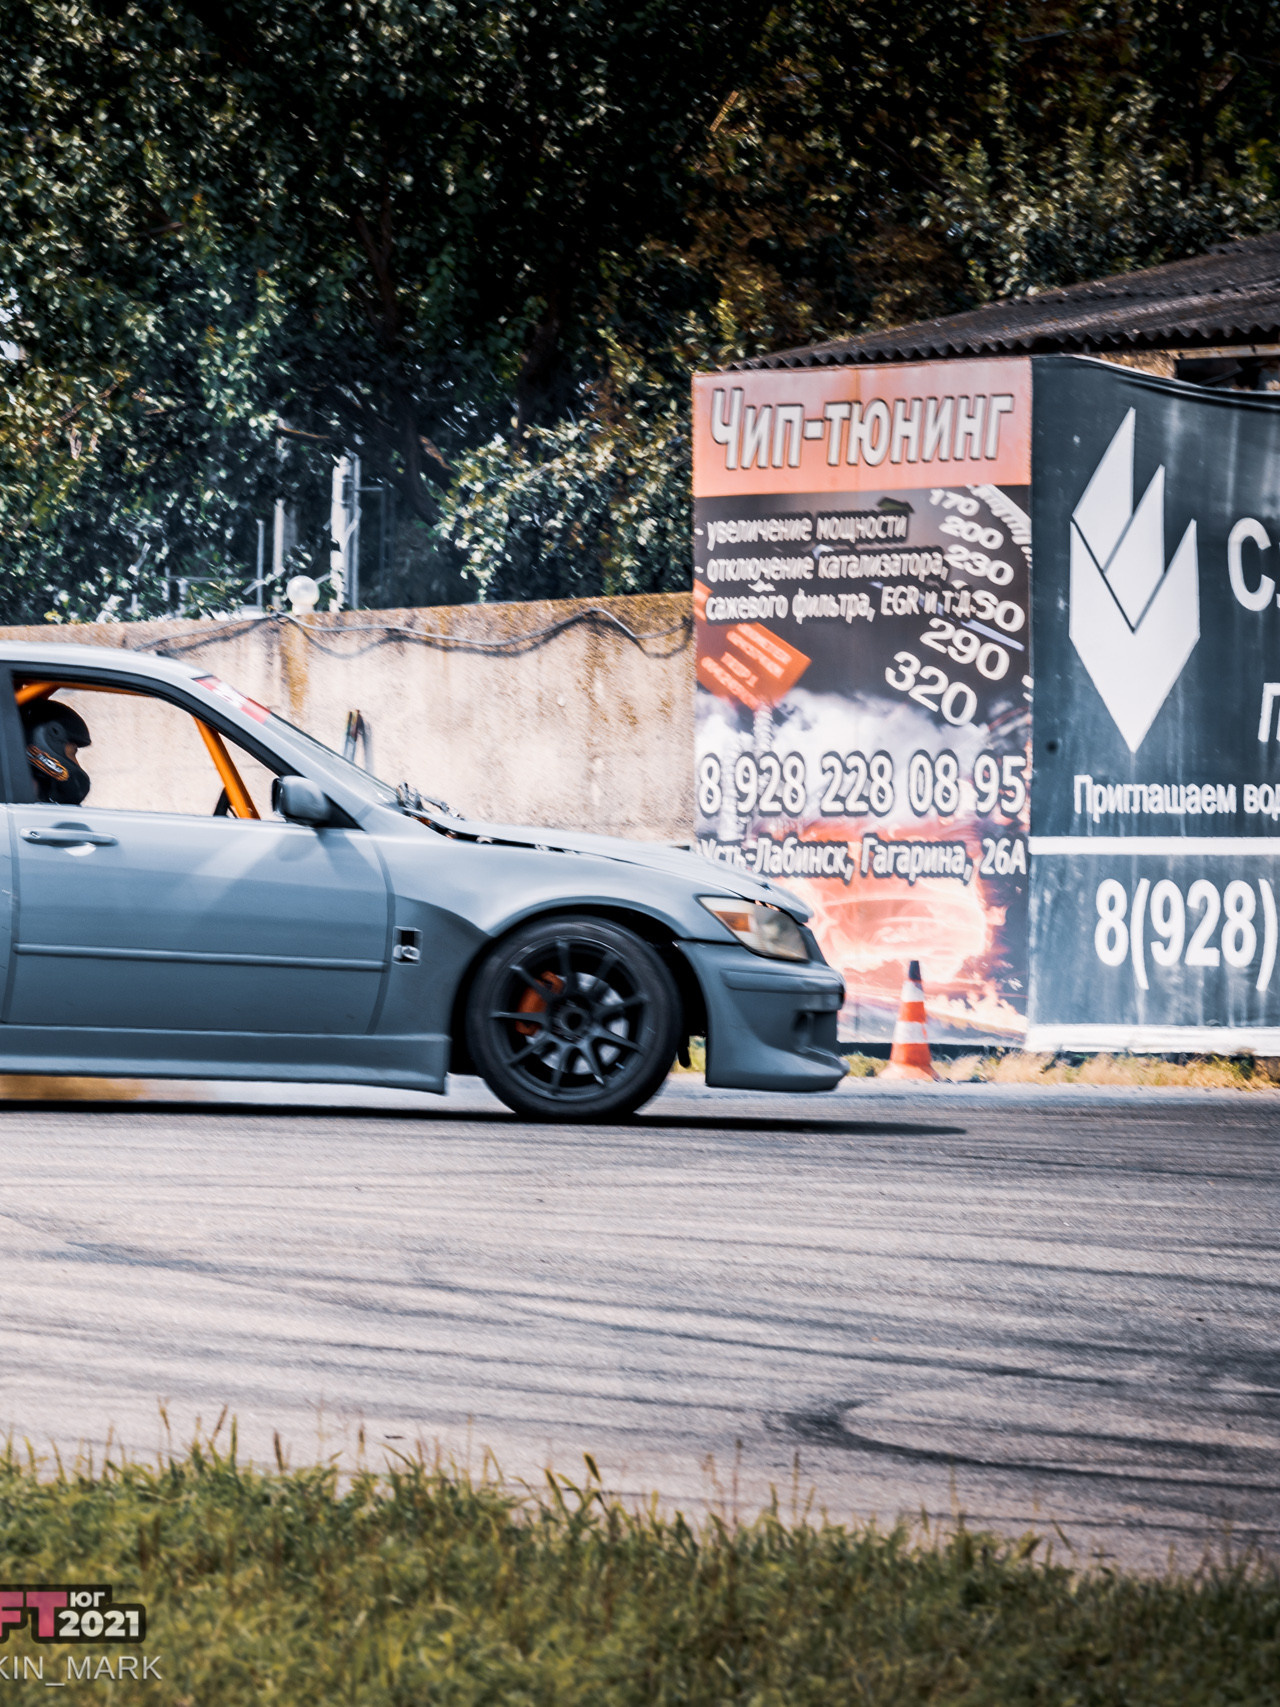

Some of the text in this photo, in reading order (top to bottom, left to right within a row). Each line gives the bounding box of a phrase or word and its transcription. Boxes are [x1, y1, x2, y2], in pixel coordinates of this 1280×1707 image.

[928, 488, 980, 516] 170
[706, 517, 813, 551] увеличение
[816, 515, 908, 543] мощности
[938, 515, 1004, 550] 200
[706, 556, 815, 583] отключение
[817, 551, 949, 582] катализатора,
[943, 544, 1015, 586] 230
[705, 594, 789, 620] сажевого
[791, 587, 876, 624] фильтра,
[880, 585, 920, 616] EGR
[923, 590, 938, 615] и
[919, 617, 1010, 681] 290
[884, 651, 978, 727] 320
[698, 753, 1026, 814] 8 928 228 08 95
[1073, 774, 1237, 824] Приглашаем
[860, 837, 973, 882] Гагарина,
[1094, 878, 1279, 991] 8(928)
